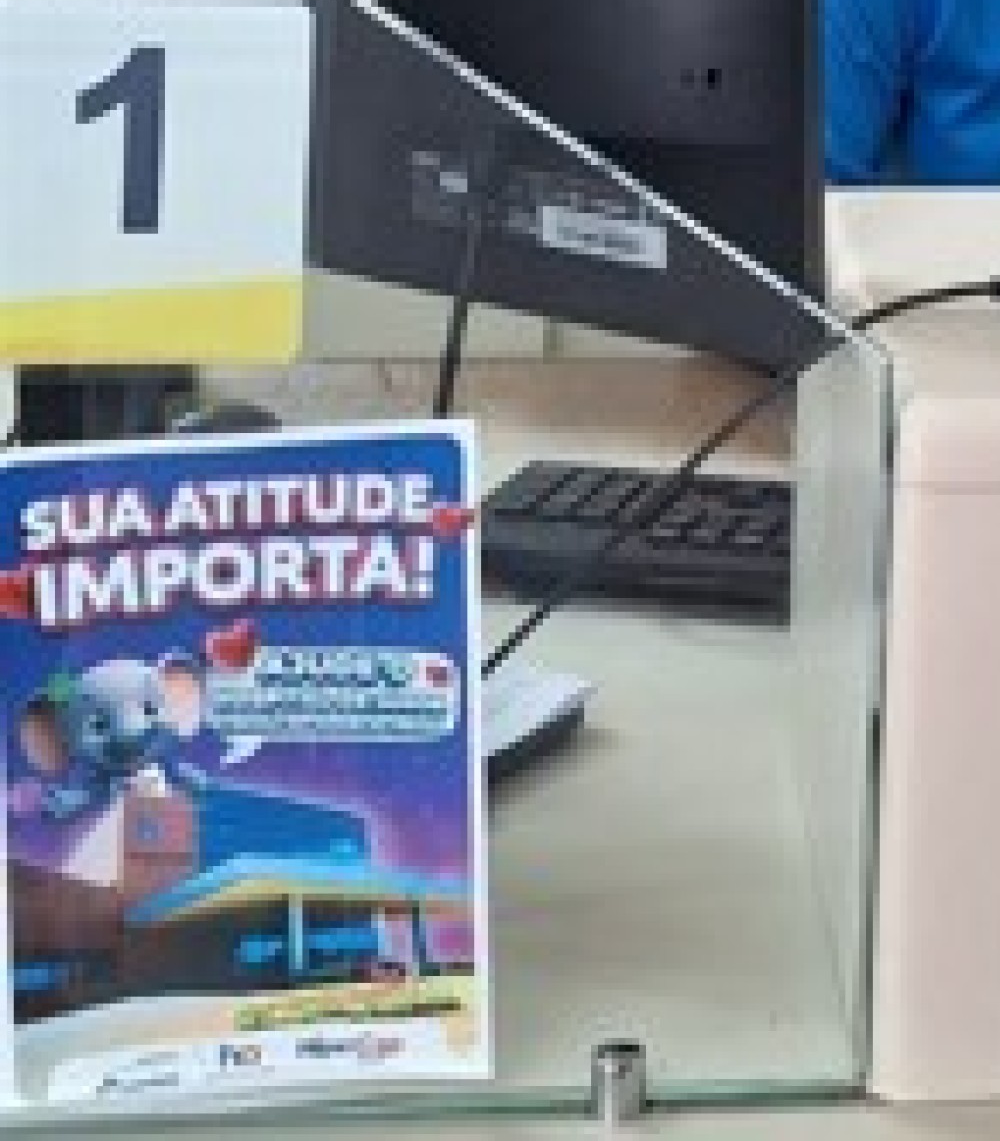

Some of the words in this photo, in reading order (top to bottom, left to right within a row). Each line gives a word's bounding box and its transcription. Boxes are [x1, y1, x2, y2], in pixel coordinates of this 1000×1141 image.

[74, 44, 166, 235] 1
[20, 487, 153, 551] SUA
[164, 473, 435, 531] ATITUDE
[36, 536, 436, 626] IMPORTA!
